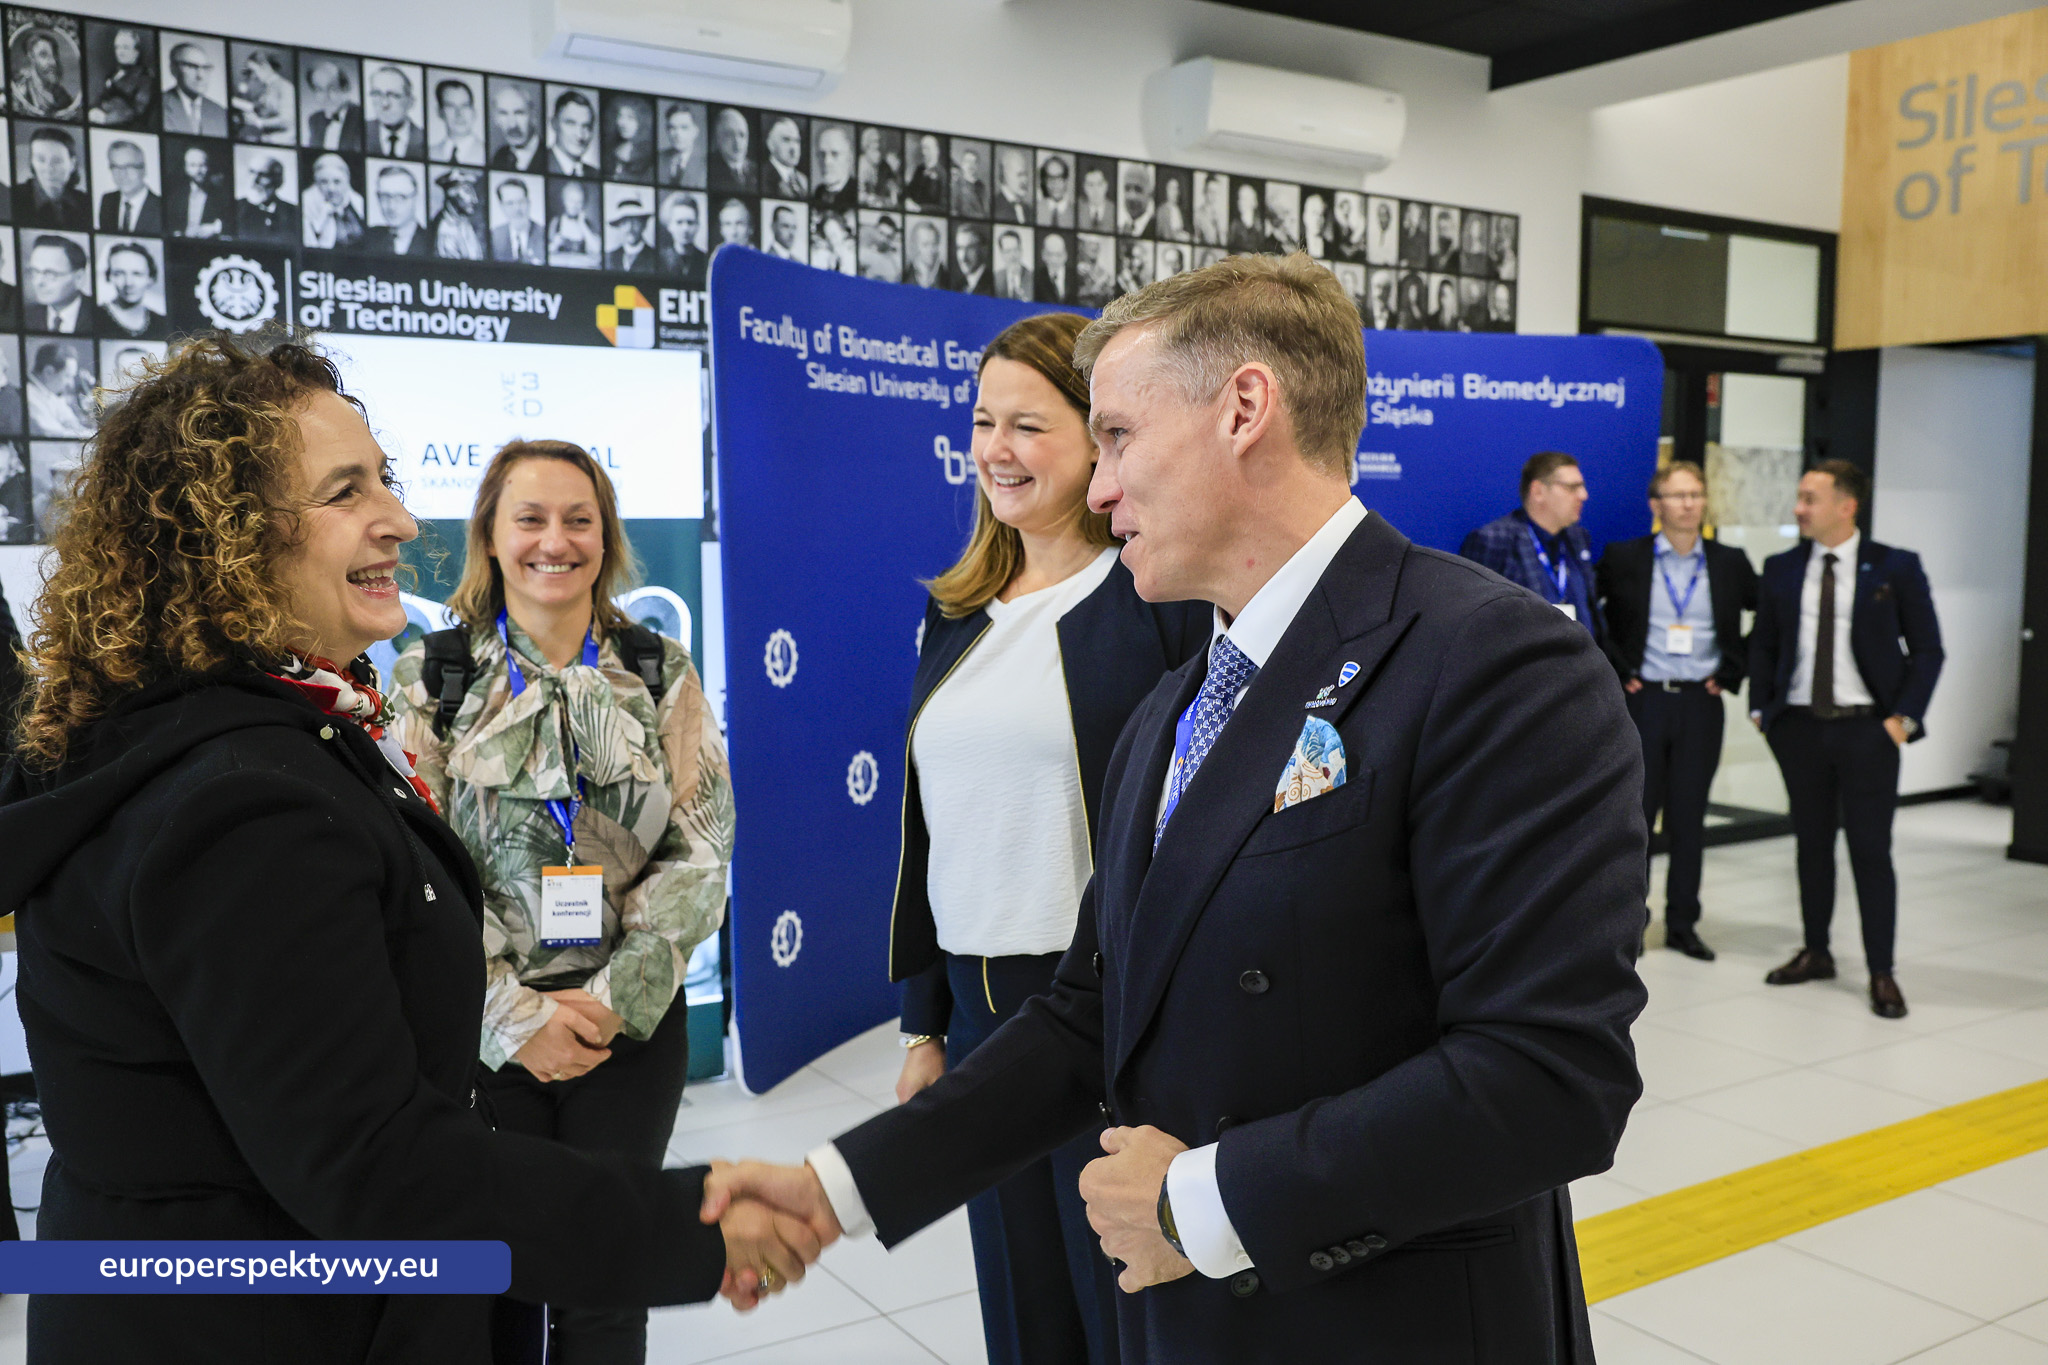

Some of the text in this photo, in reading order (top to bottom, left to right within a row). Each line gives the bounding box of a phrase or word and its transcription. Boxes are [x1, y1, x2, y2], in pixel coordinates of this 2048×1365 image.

[1894, 135, 2048, 220] of T
[298, 270, 563, 320] Silesian University
[659, 288, 711, 324] EHT
[299, 299, 511, 342] of Technology
[739, 305, 986, 374] Faculty of Biomedical Eng
[805, 361, 868, 395] Silesian
[870, 370, 951, 409] University
[953, 379, 970, 404] of
[1463, 373, 1626, 409] Biomedycznej
[421, 444, 481, 467] AVE
